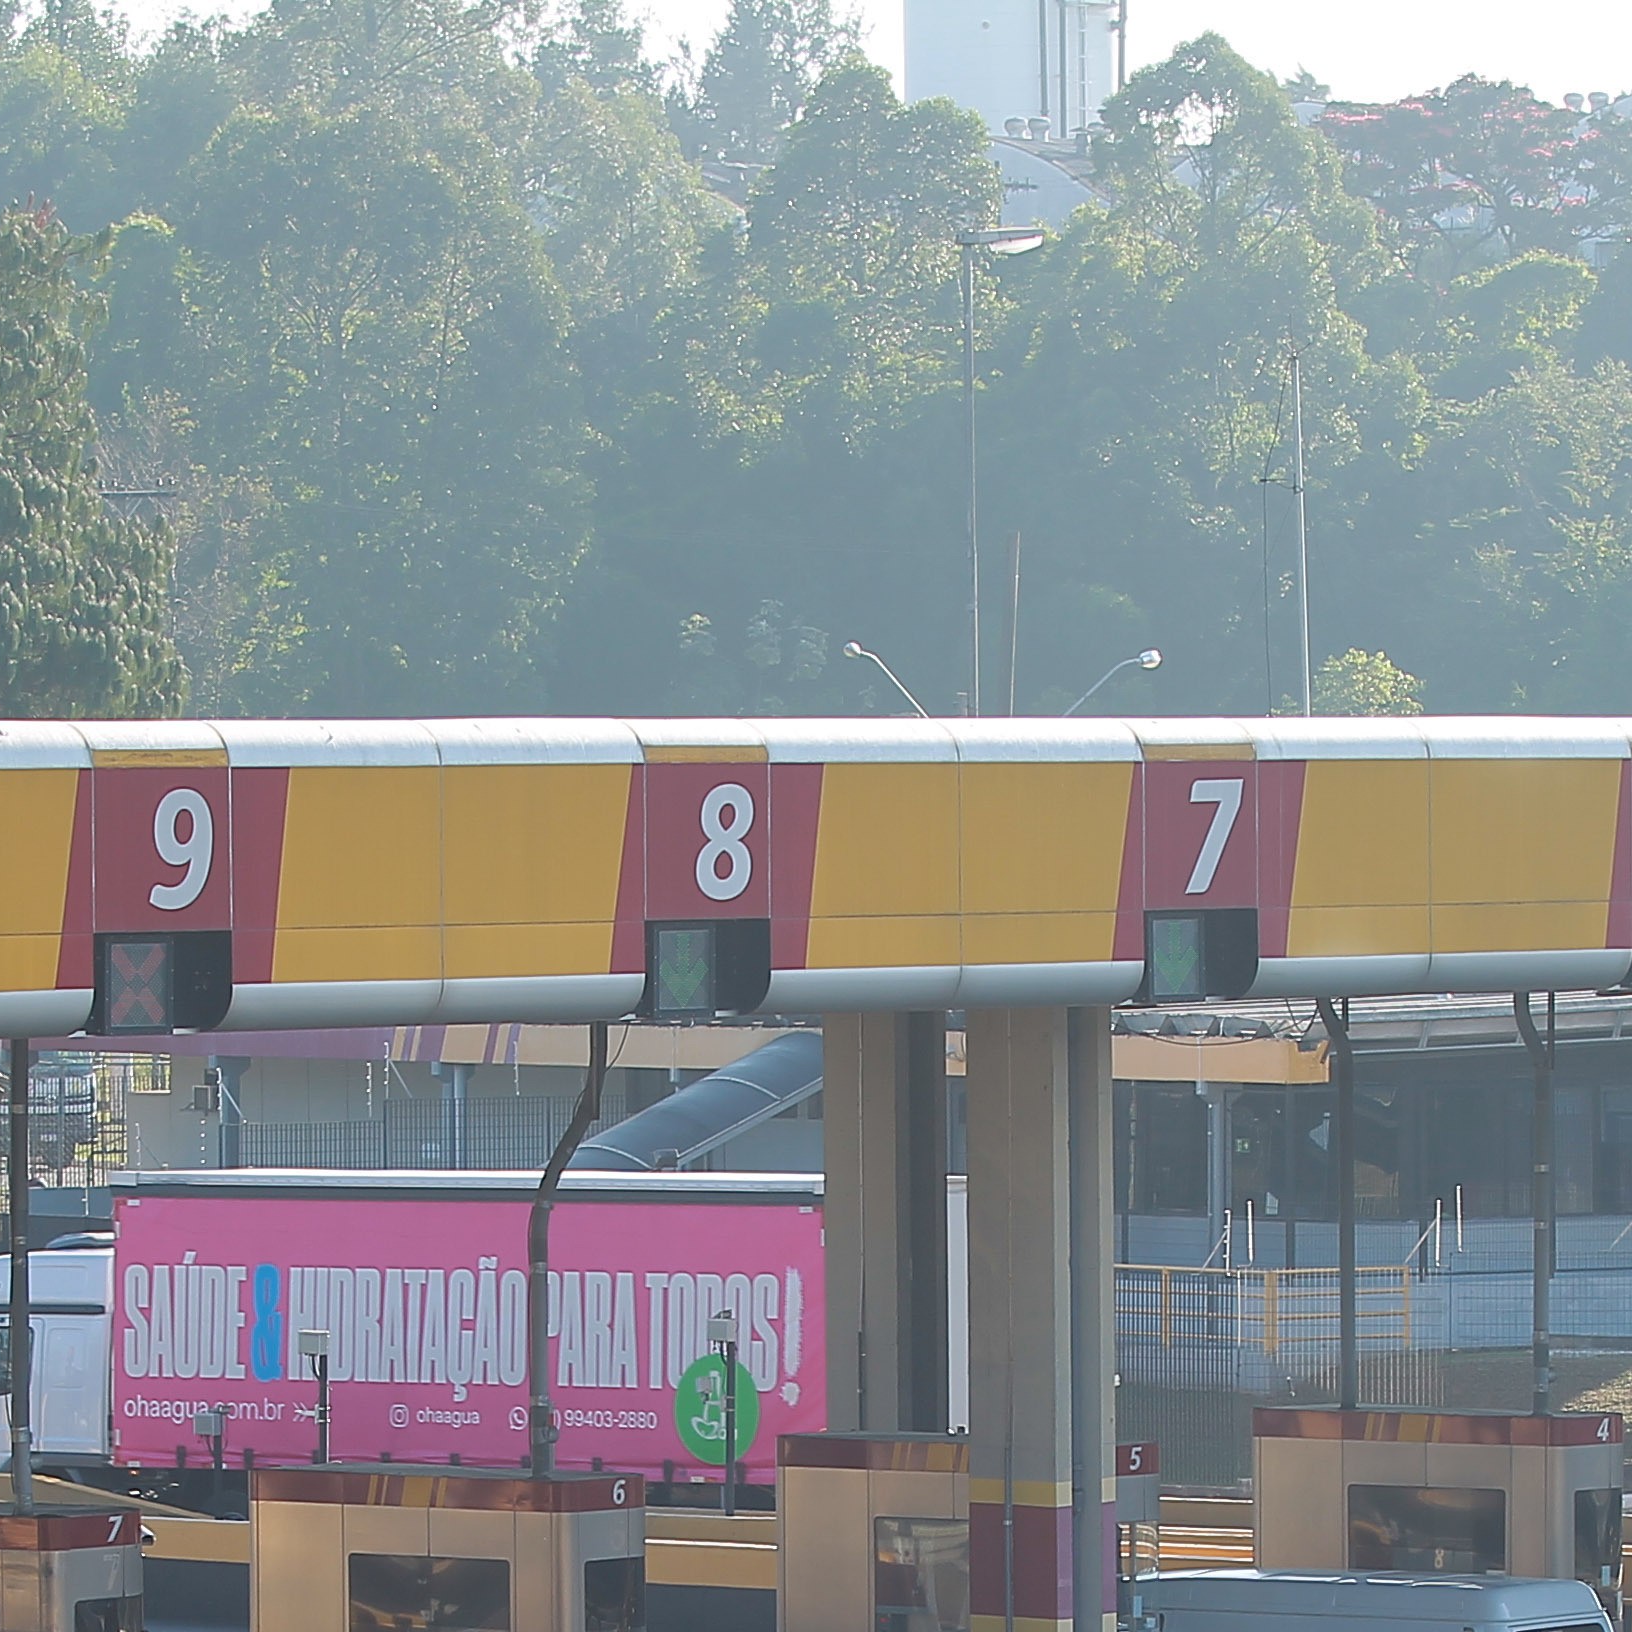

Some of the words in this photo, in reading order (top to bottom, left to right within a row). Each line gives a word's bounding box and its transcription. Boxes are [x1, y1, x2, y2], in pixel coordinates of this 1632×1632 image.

[148, 787, 214, 912] 9
[694, 782, 754, 903] 8
[1183, 777, 1246, 896] 7
[123, 1250, 247, 1380] SAÚDE
[251, 1263, 283, 1382] &
[287, 1255, 527, 1402] HIDRATAÇÃO
[416, 1406, 480, 1428] ohaagua
[565, 1409, 657, 1429] 99403-2880
[1596, 1417, 1610, 1442] 4
[1128, 1446, 1143, 1471] 5
[612, 1478, 627, 1506] 6
[107, 1515, 123, 1543] 7
